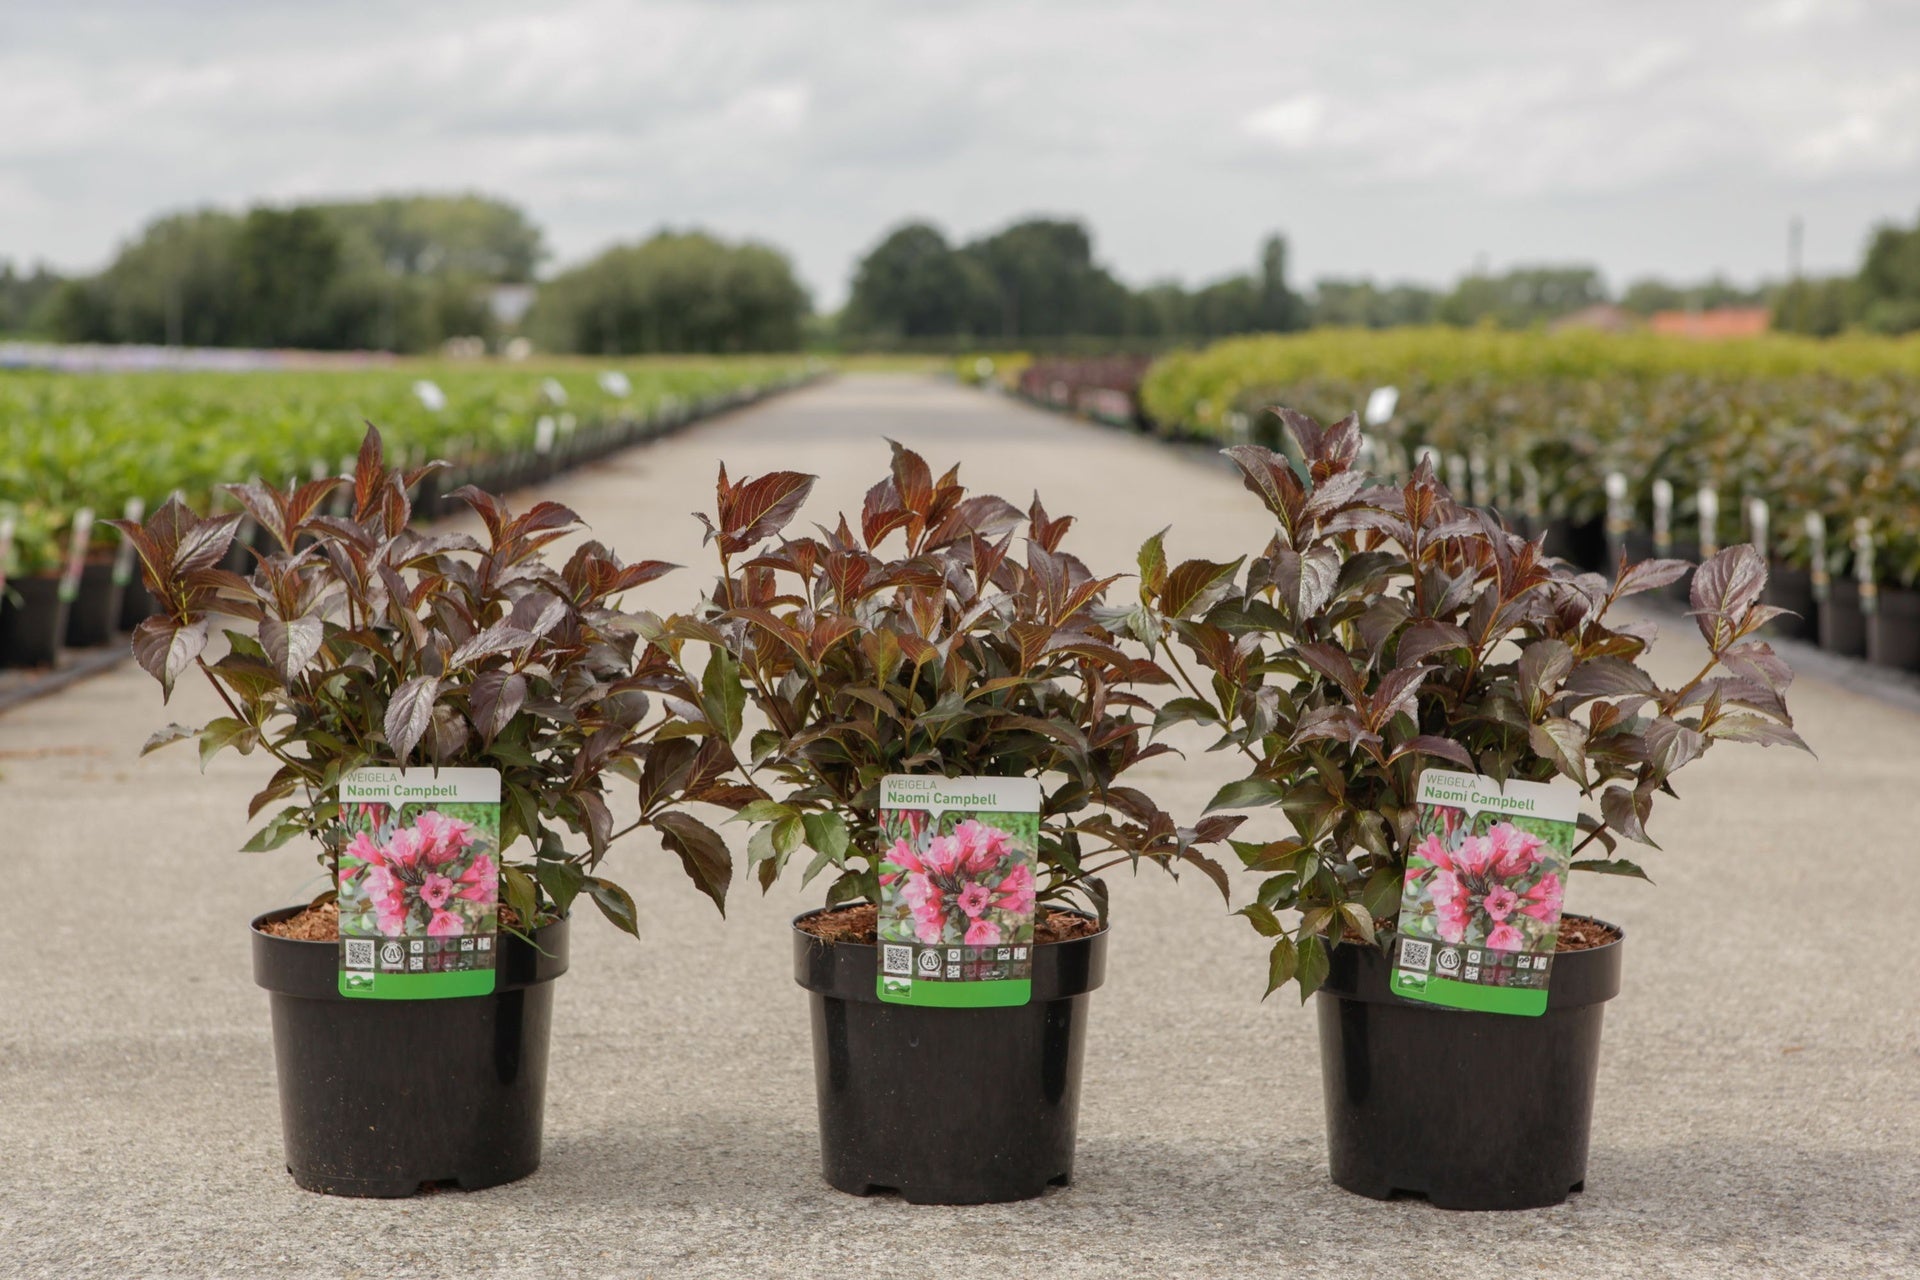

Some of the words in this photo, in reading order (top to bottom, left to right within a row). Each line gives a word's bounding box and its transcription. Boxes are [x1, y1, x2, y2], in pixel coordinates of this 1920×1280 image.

[347, 772, 397, 783] WEIGELA
[887, 779, 937, 790] WEIGELA
[1426, 773, 1476, 789] WEIGELA
[347, 784, 390, 796] Naomi
[394, 784, 457, 799] Campbell
[887, 791, 930, 804] Naomi
[933, 792, 997, 807] Campbell
[1424, 785, 1467, 802] Naomi
[1471, 792, 1535, 811] Campbell
